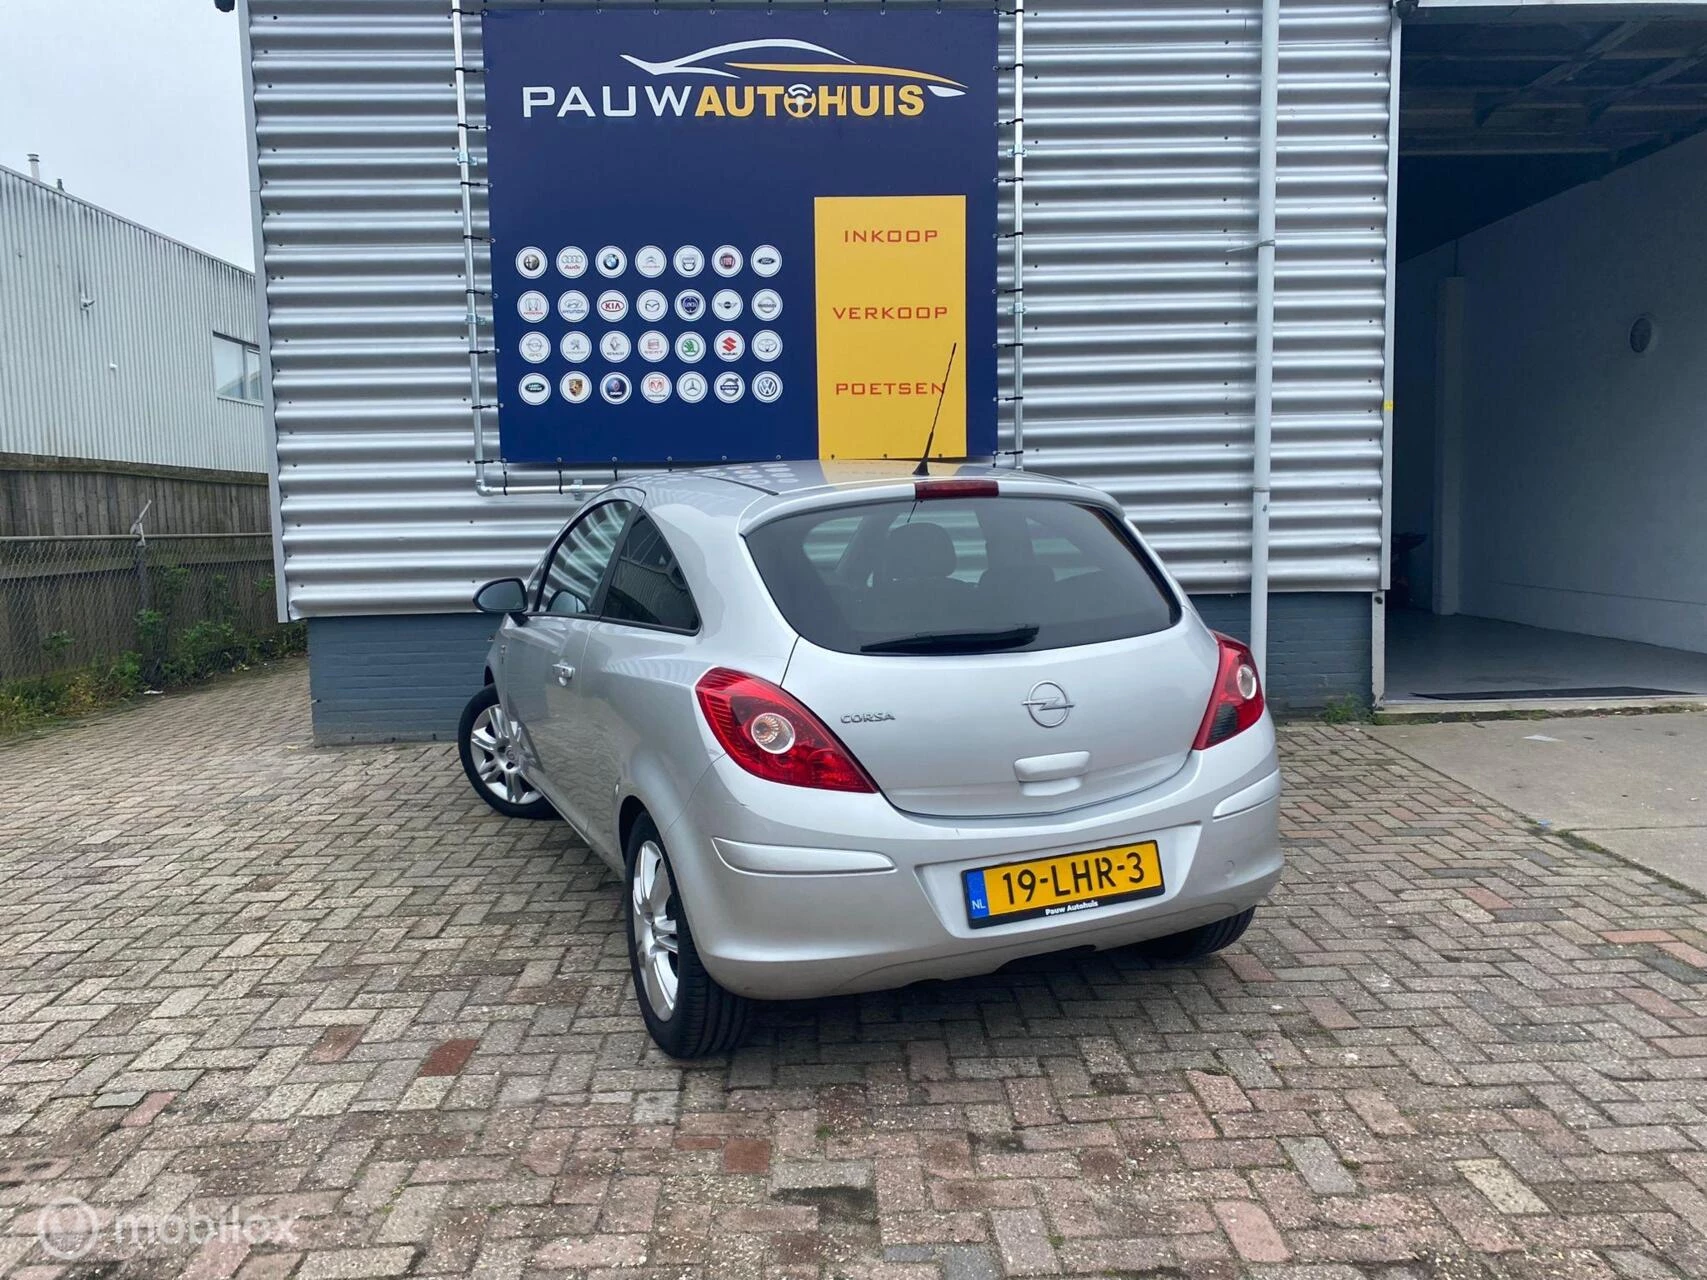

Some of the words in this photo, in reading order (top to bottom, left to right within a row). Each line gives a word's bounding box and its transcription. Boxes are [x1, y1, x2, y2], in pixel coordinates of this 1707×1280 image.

[844, 230, 938, 243] INKOOP
[832, 306, 948, 320] VERKOOP
[835, 382, 947, 395] POETSEN
[840, 712, 896, 724] CORSA
[1002, 852, 1145, 905] 19-LHR-3
[971, 900, 986, 911] NL
[1045, 907, 1066, 916] Pauw
[1066, 899, 1099, 912] Autohuis
